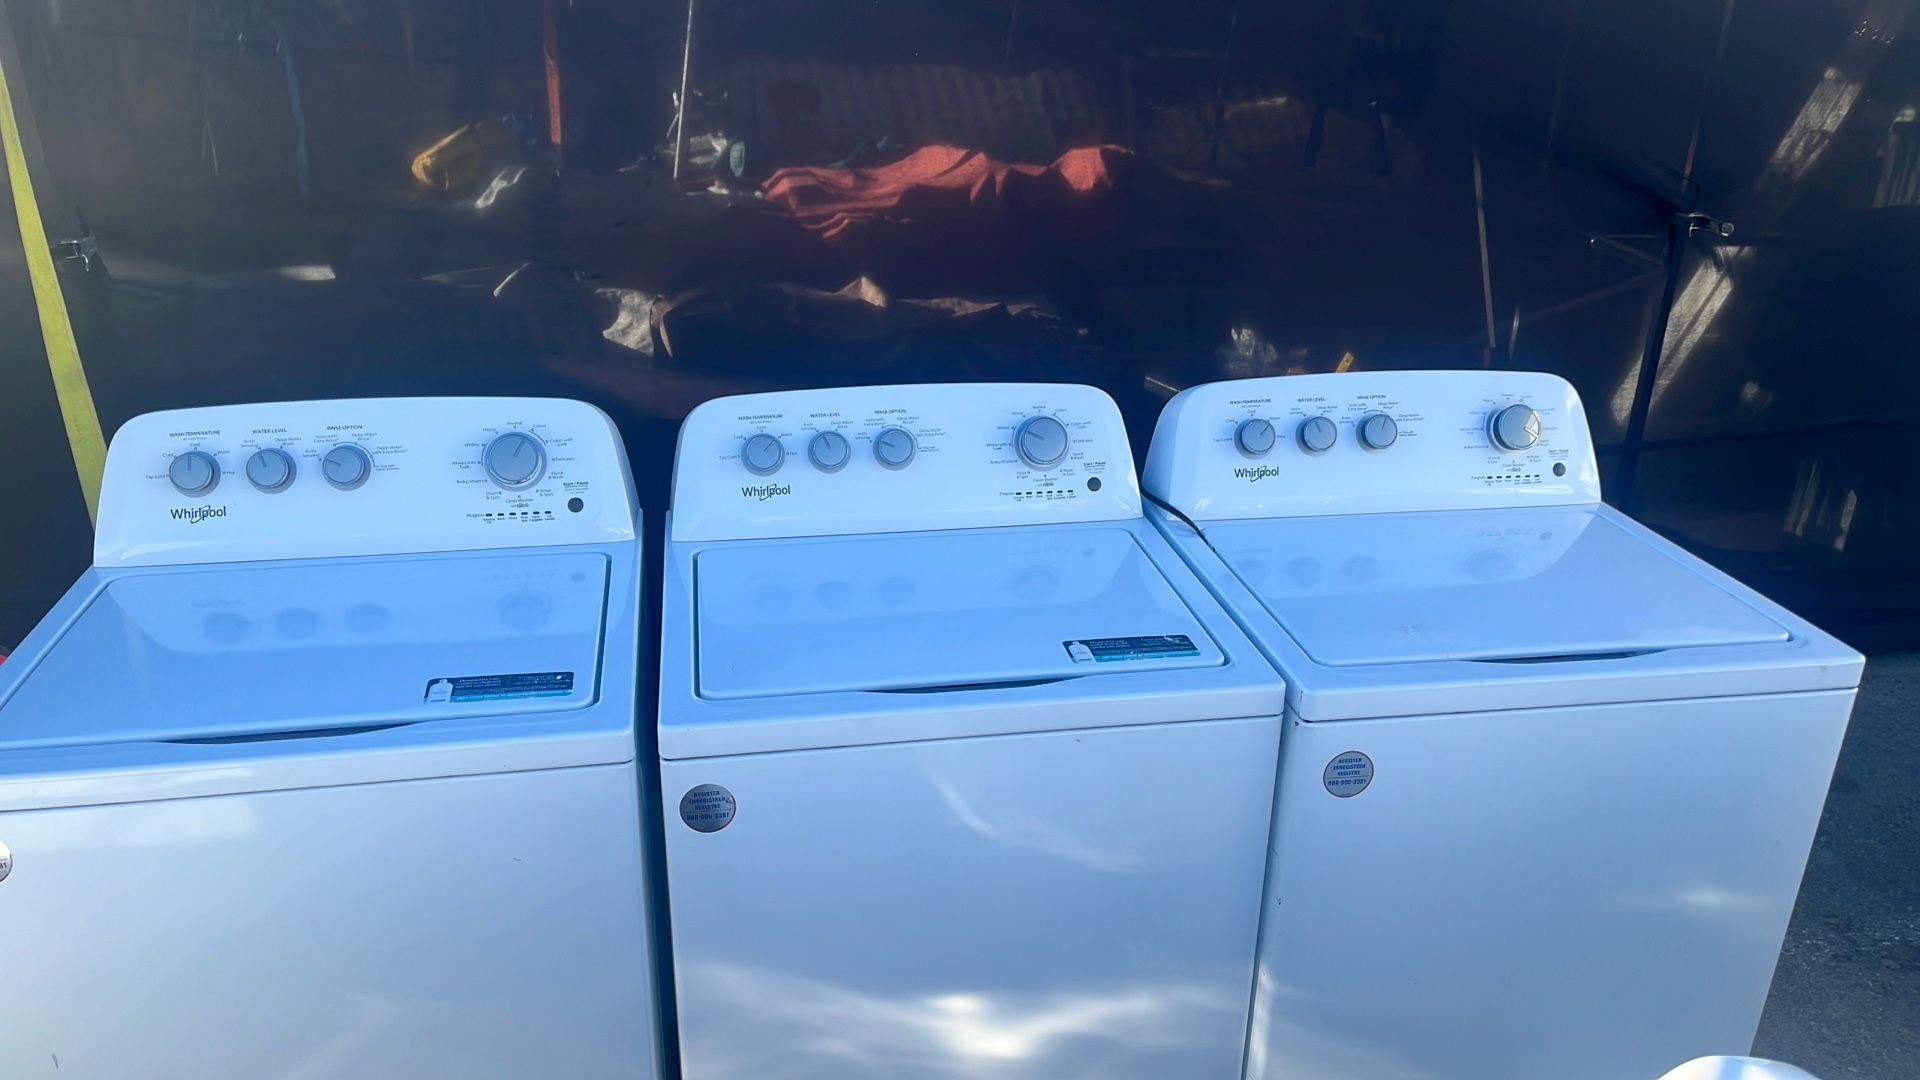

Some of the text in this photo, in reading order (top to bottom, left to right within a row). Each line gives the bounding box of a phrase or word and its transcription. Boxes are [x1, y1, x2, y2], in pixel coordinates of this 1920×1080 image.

[184, 429, 221, 437] TEMPERATURE
[1234, 465, 1279, 483] Whirlpool
[741, 483, 791, 502] Whirlpool
[170, 505, 227, 524] Whirlpool
[693, 790, 720, 799] REGISTER
